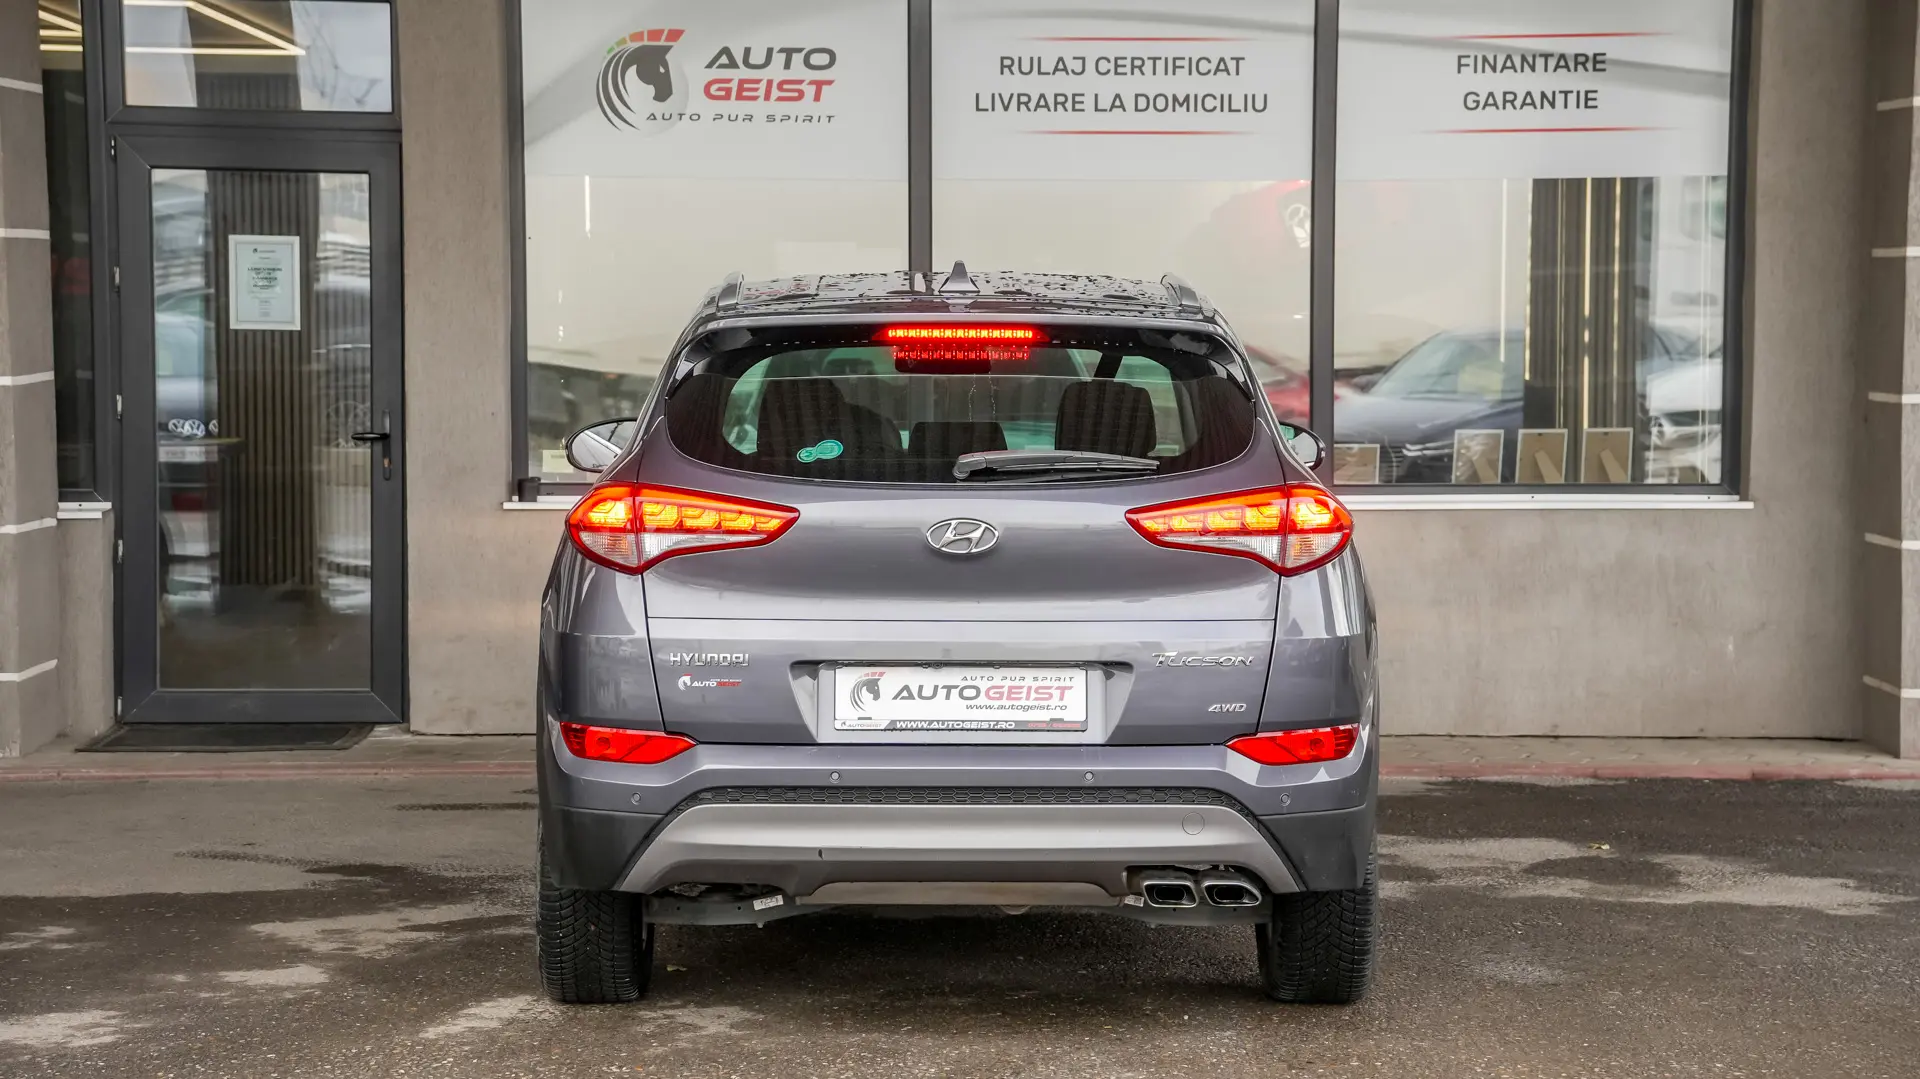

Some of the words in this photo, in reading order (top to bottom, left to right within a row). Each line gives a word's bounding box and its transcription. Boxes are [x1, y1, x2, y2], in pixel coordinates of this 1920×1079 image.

[704, 46, 837, 71] AUTO
[999, 56, 1087, 76] RULAJ
[1094, 56, 1245, 76] CERTIFICAT
[1457, 53, 1607, 74] FINANTARE
[703, 78, 836, 102] GEIST
[1463, 90, 1599, 110] GARANTIE
[975, 93, 1086, 112] LIVRARE
[1094, 93, 1127, 113] LA
[1134, 93, 1268, 113] DOMICILIU
[646, 112, 701, 122] AUTO
[712, 113, 754, 123] PUR
[766, 114, 836, 123] SPIRIT
[669, 653, 750, 666] HYUNDAI
[965, 704, 1068, 712] www.autogeist.ro
[1208, 703, 1247, 712] 4WD
[896, 721, 1015, 729] WWW.AUTOGEIST.RO
